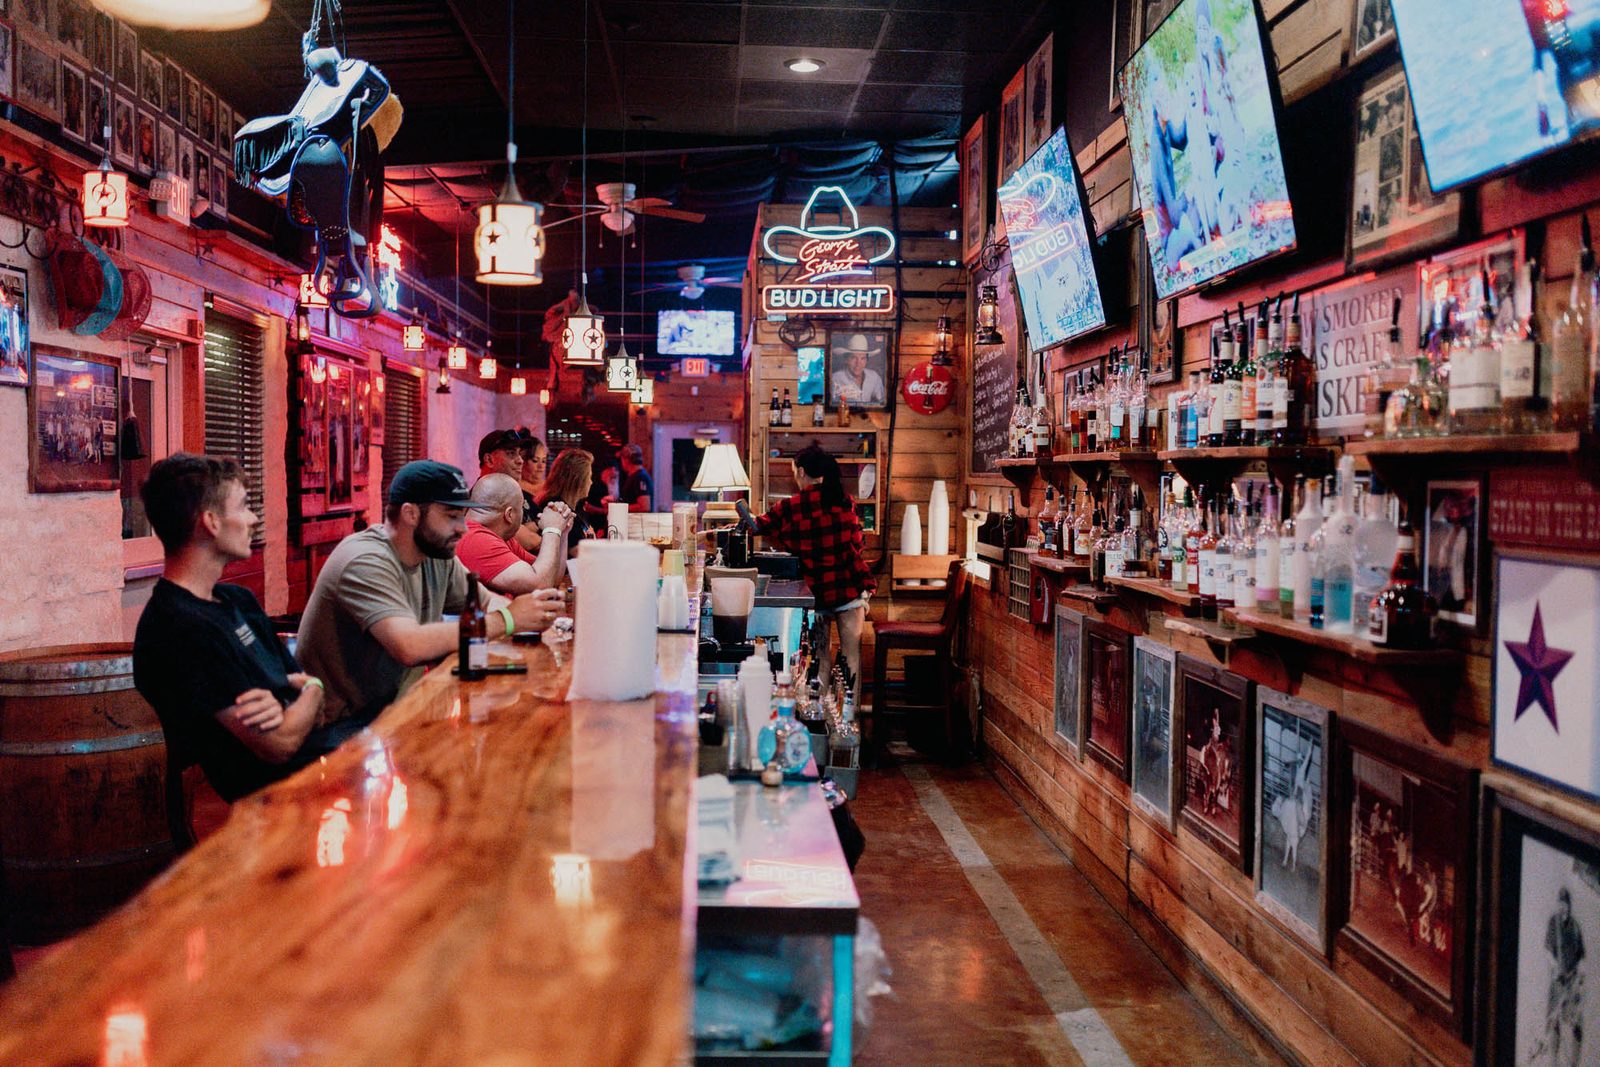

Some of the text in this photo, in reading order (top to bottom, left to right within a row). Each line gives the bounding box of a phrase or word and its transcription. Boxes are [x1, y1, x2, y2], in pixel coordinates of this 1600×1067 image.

[172, 175, 188, 219] EXIT
[799, 239, 859, 262] George
[770, 289, 888, 308] BUD LIGHT
[686, 359, 705, 374] EXIT
